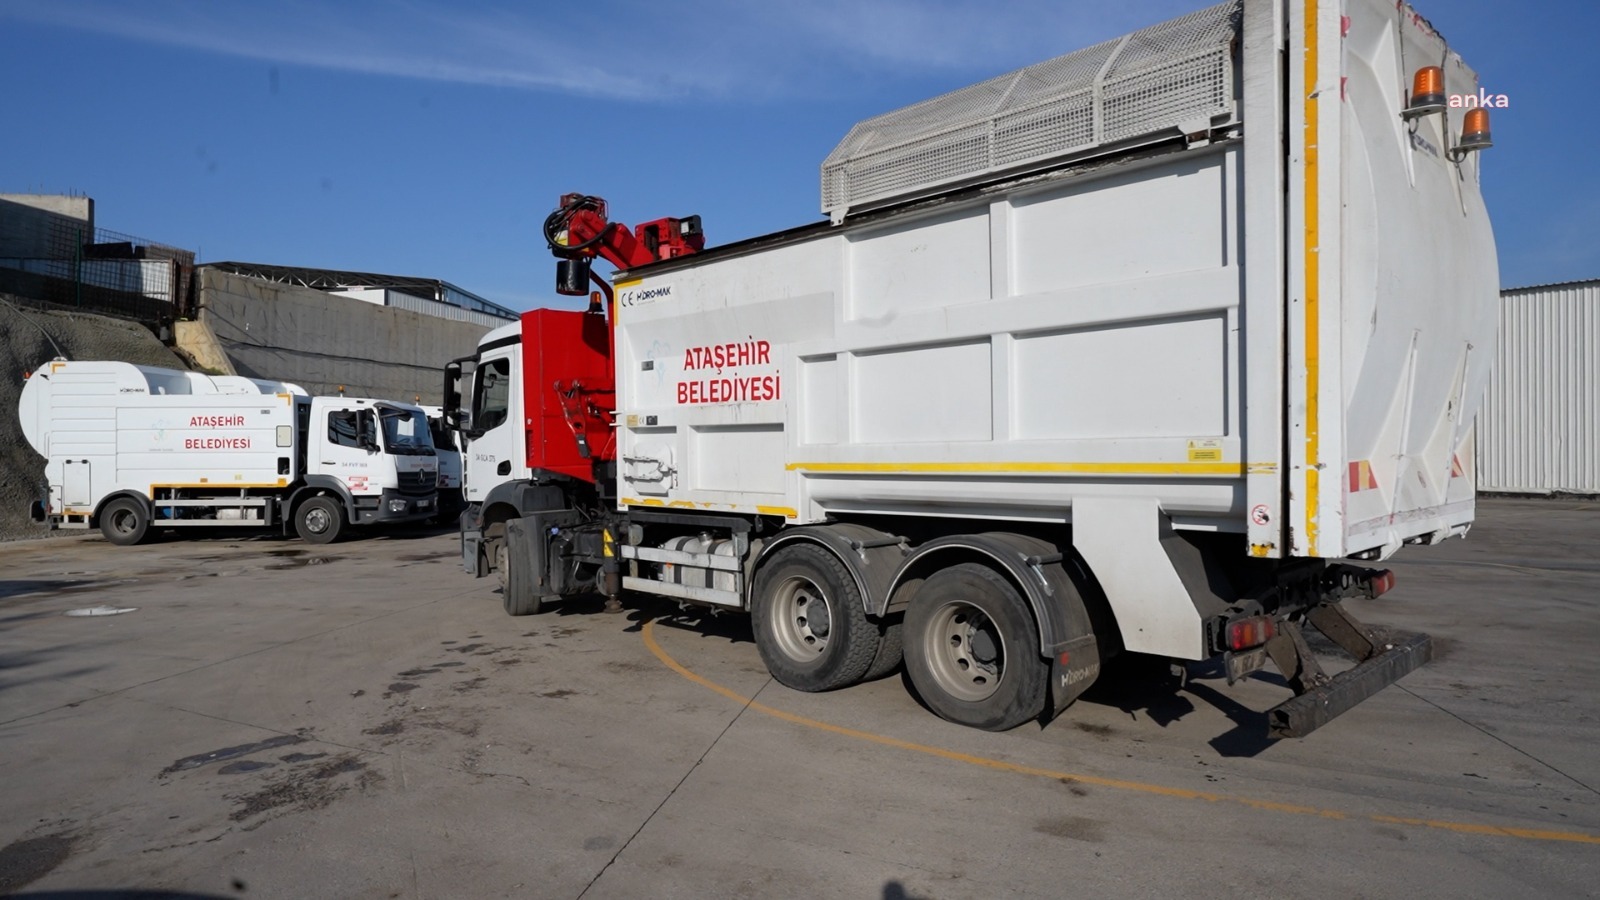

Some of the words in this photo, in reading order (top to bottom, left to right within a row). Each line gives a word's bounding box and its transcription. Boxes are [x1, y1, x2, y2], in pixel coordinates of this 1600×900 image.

[684, 335, 770, 375] ATAŞEHİR
[677, 369, 780, 404] BELEDİYESİ
[190, 413, 245, 430] ATAŞEHİR
[185, 436, 251, 449] BELEDİYESİ
